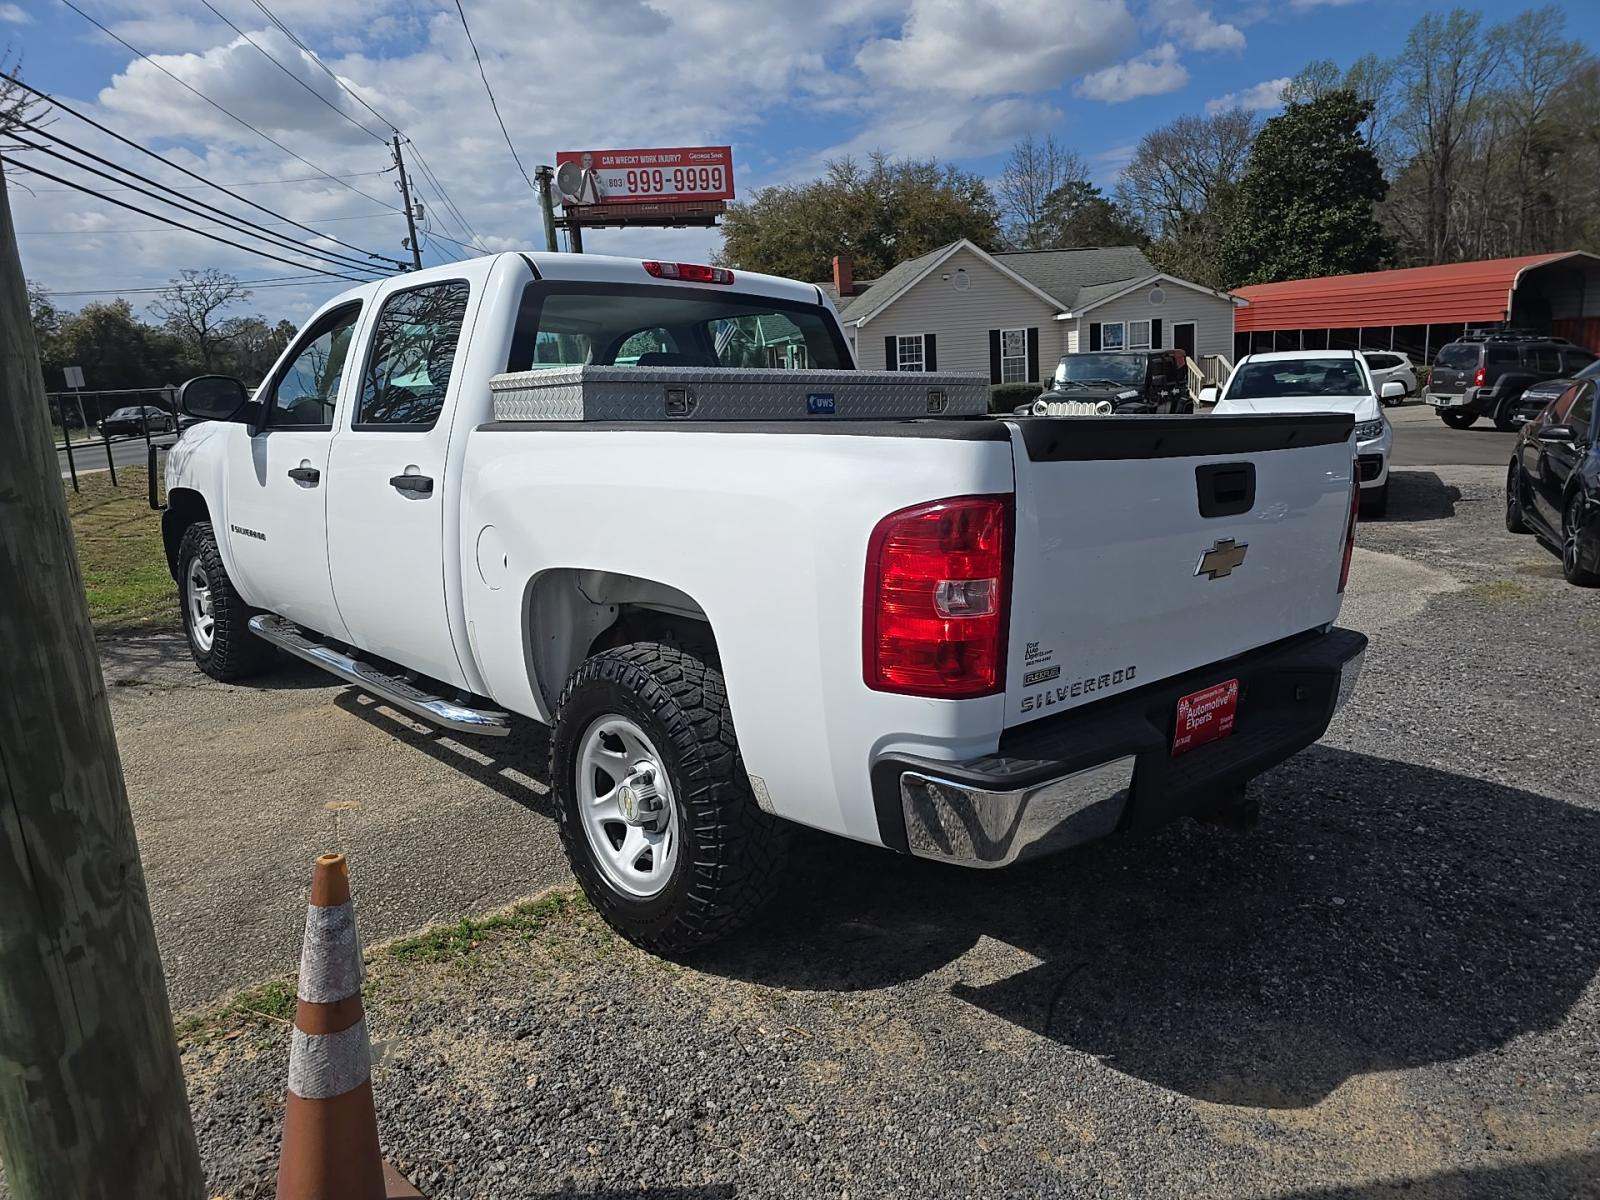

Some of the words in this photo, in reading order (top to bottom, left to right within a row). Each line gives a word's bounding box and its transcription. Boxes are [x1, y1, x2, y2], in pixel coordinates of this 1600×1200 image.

[602, 156, 614, 165] CAR
[615, 156, 638, 165] WRECK?
[640, 154, 657, 164] WORK
[658, 153, 682, 163] INJURY?
[608, 178, 623, 188] 803
[627, 167, 722, 193] 999-9999
[816, 398, 834, 408] UWS
[1020, 665, 1137, 714] SILVERADO
[1186, 695, 1230, 720] Automotive
[1186, 712, 1213, 731] Experts
